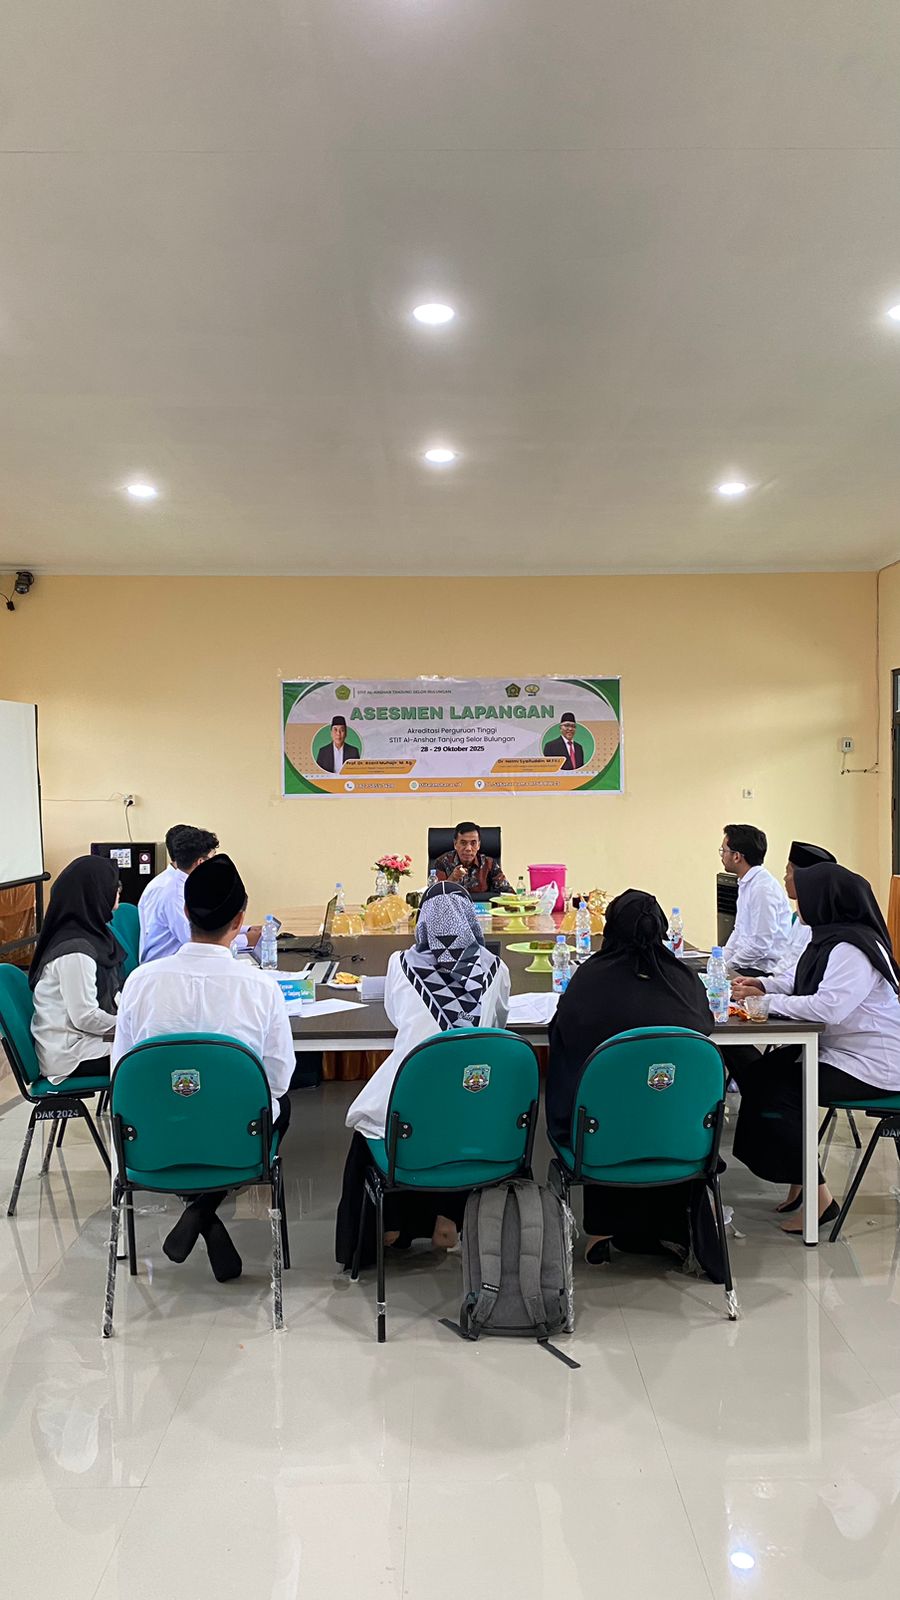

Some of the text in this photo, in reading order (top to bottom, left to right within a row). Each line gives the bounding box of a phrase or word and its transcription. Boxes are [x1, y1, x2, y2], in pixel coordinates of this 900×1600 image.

[350, 705, 555, 721] ASESMEN LAPANGAN
[441, 728, 476, 736] Perguruan
[477, 727, 498, 735] Tinggi
[438, 736, 465, 744] Tanjung
[484, 736, 516, 744] Bulungan
[35, 1110, 79, 1119] DAK 2024
